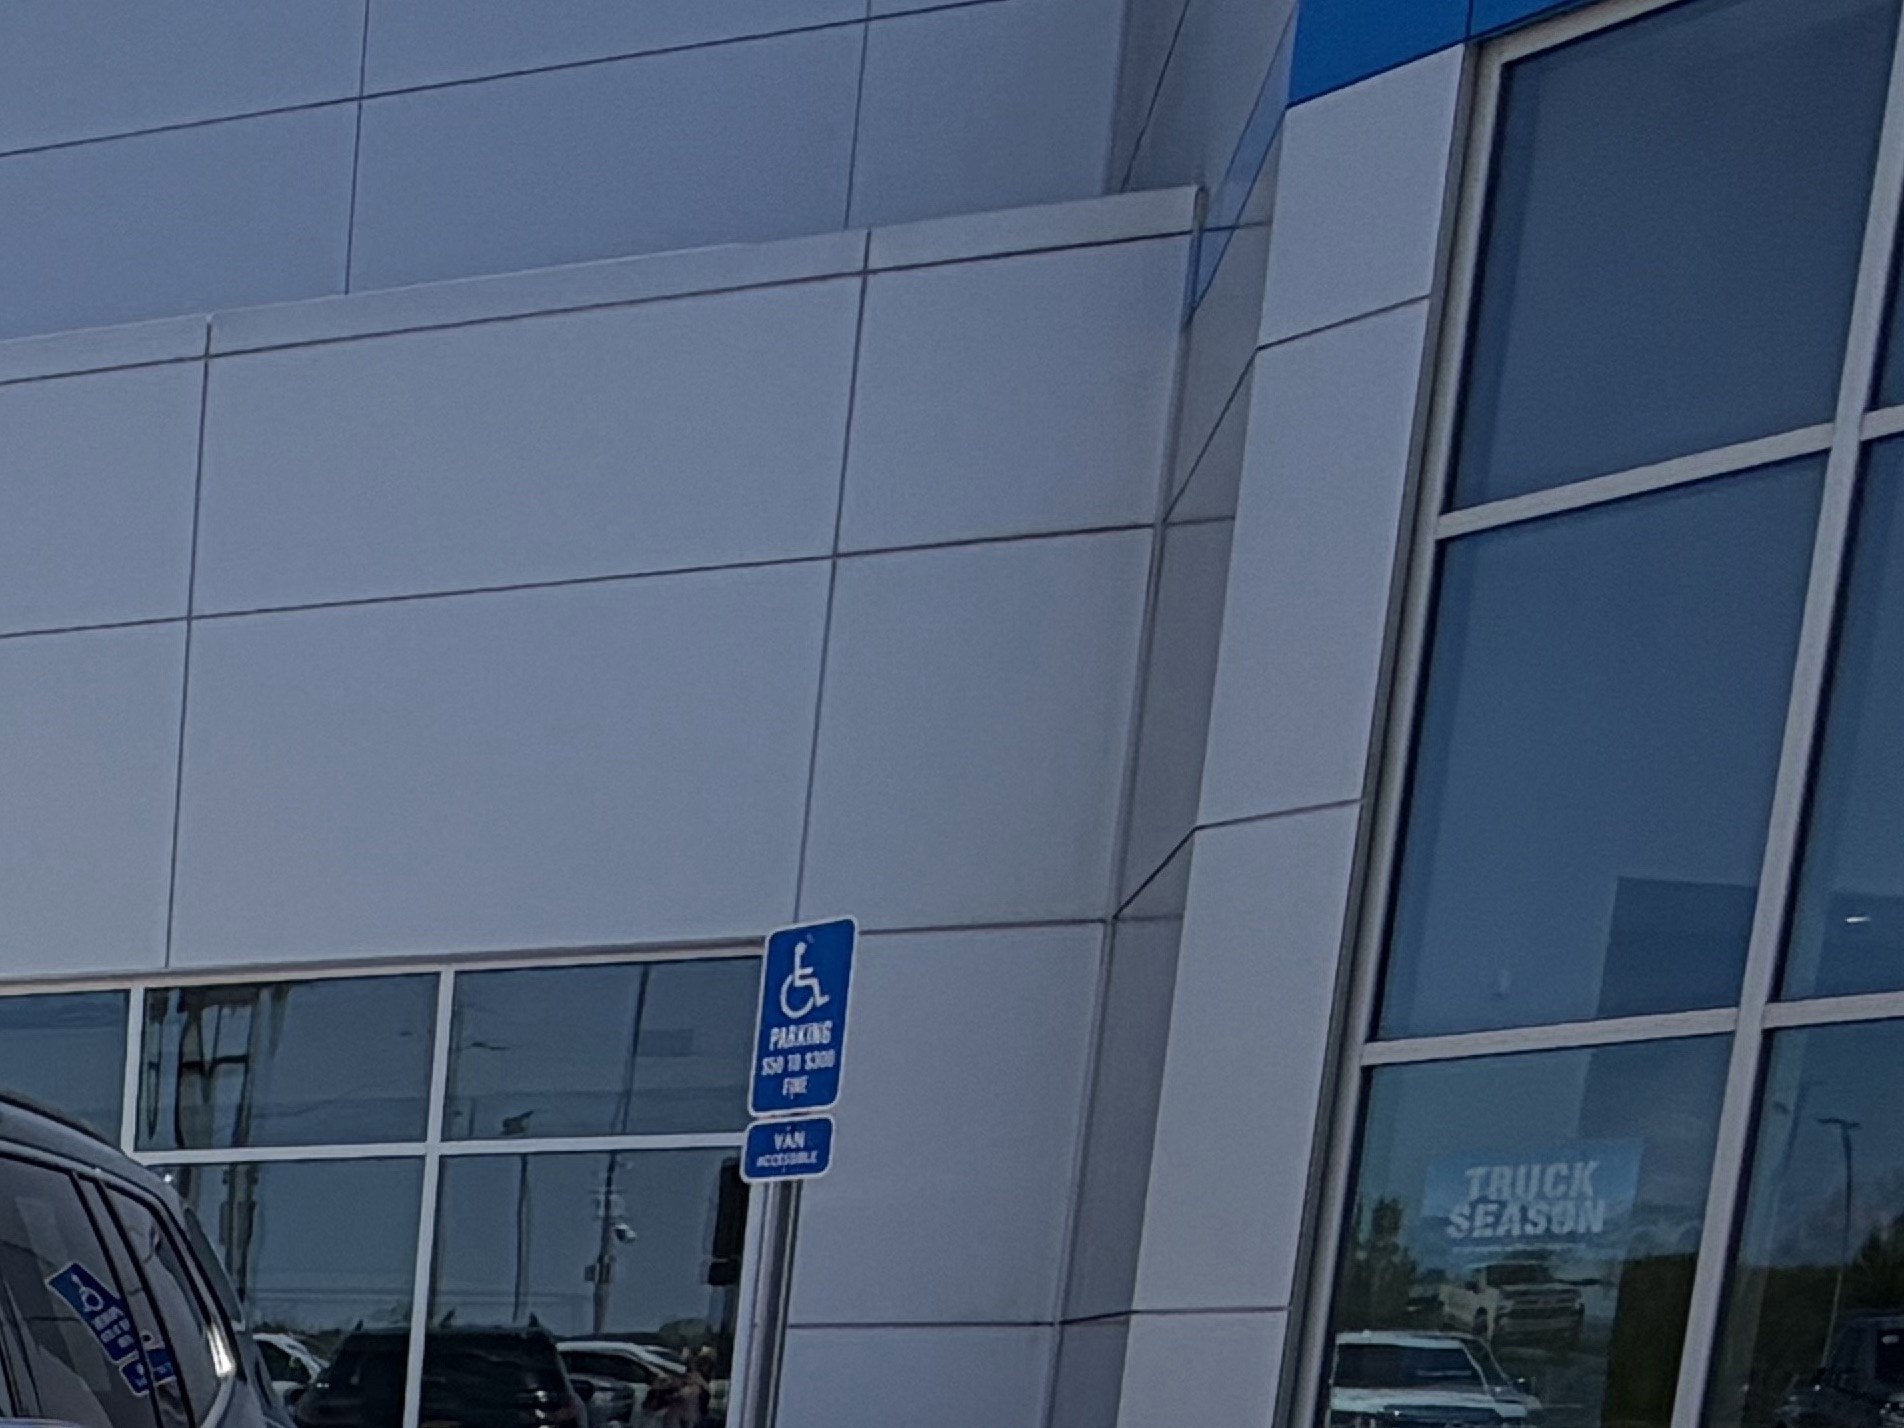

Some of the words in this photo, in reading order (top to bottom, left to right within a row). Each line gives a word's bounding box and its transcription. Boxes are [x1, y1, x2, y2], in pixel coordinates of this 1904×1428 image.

[769, 1020, 833, 1051] PARKING
[787, 1053, 802, 1072] TO
[782, 1075, 809, 1096] FINE
[774, 1130, 806, 1151] VAN
[1465, 1161, 1600, 1200] TRUCK
[1446, 1200, 1604, 1238] SEASON
